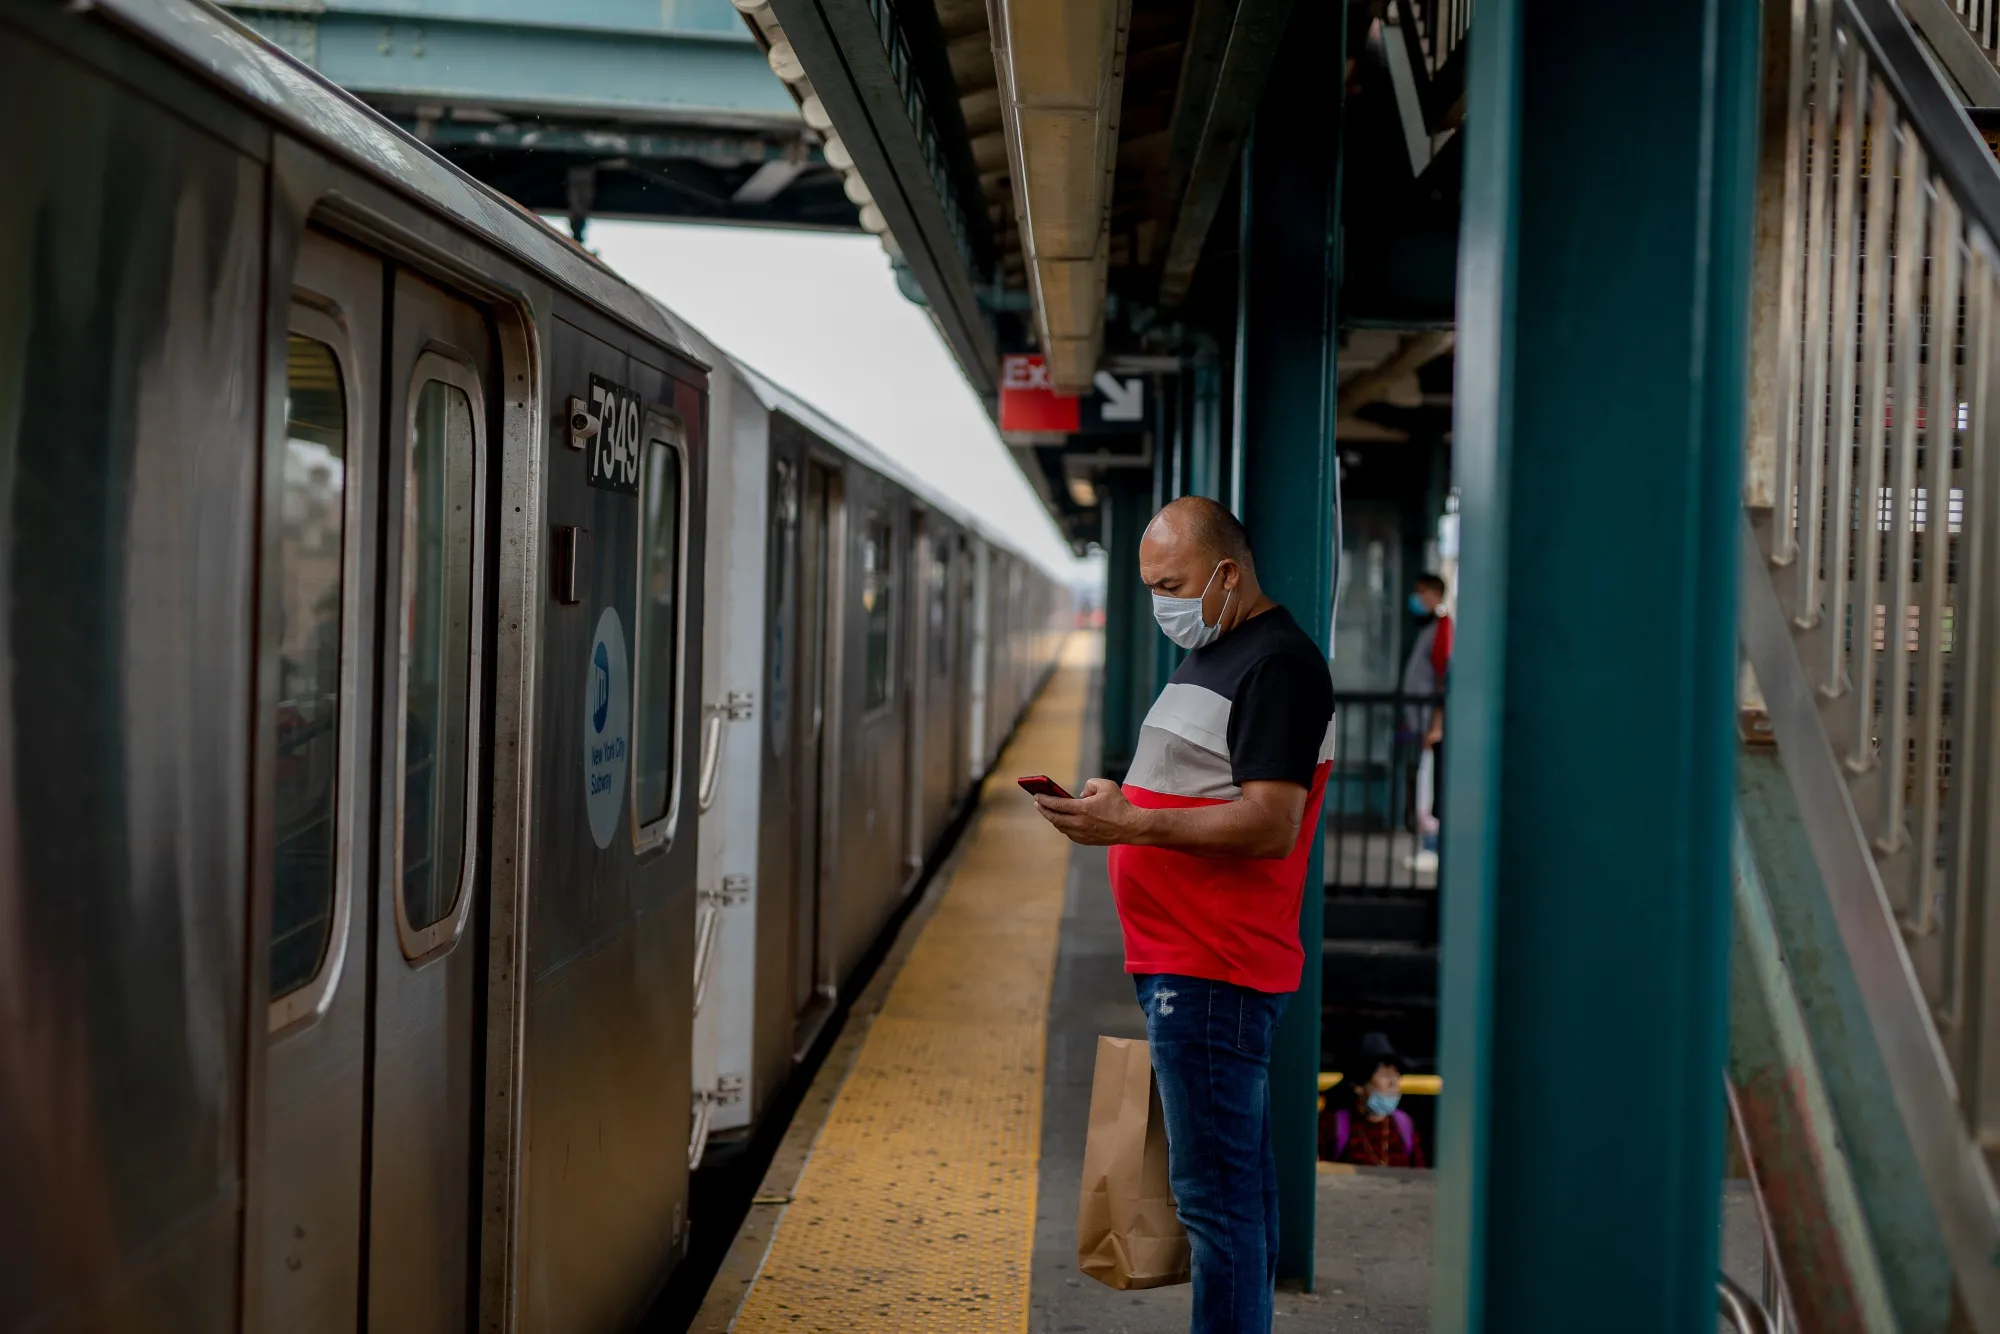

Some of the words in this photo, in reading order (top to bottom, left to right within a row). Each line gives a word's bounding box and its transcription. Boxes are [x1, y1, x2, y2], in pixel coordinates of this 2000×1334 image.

[1004, 357, 1052, 389] Ex
[593, 385, 639, 485] 7349
[591, 745, 603, 766] New
[603, 740, 615, 762] York
[615, 736, 625, 762] City
[590, 772, 612, 796] Subway
